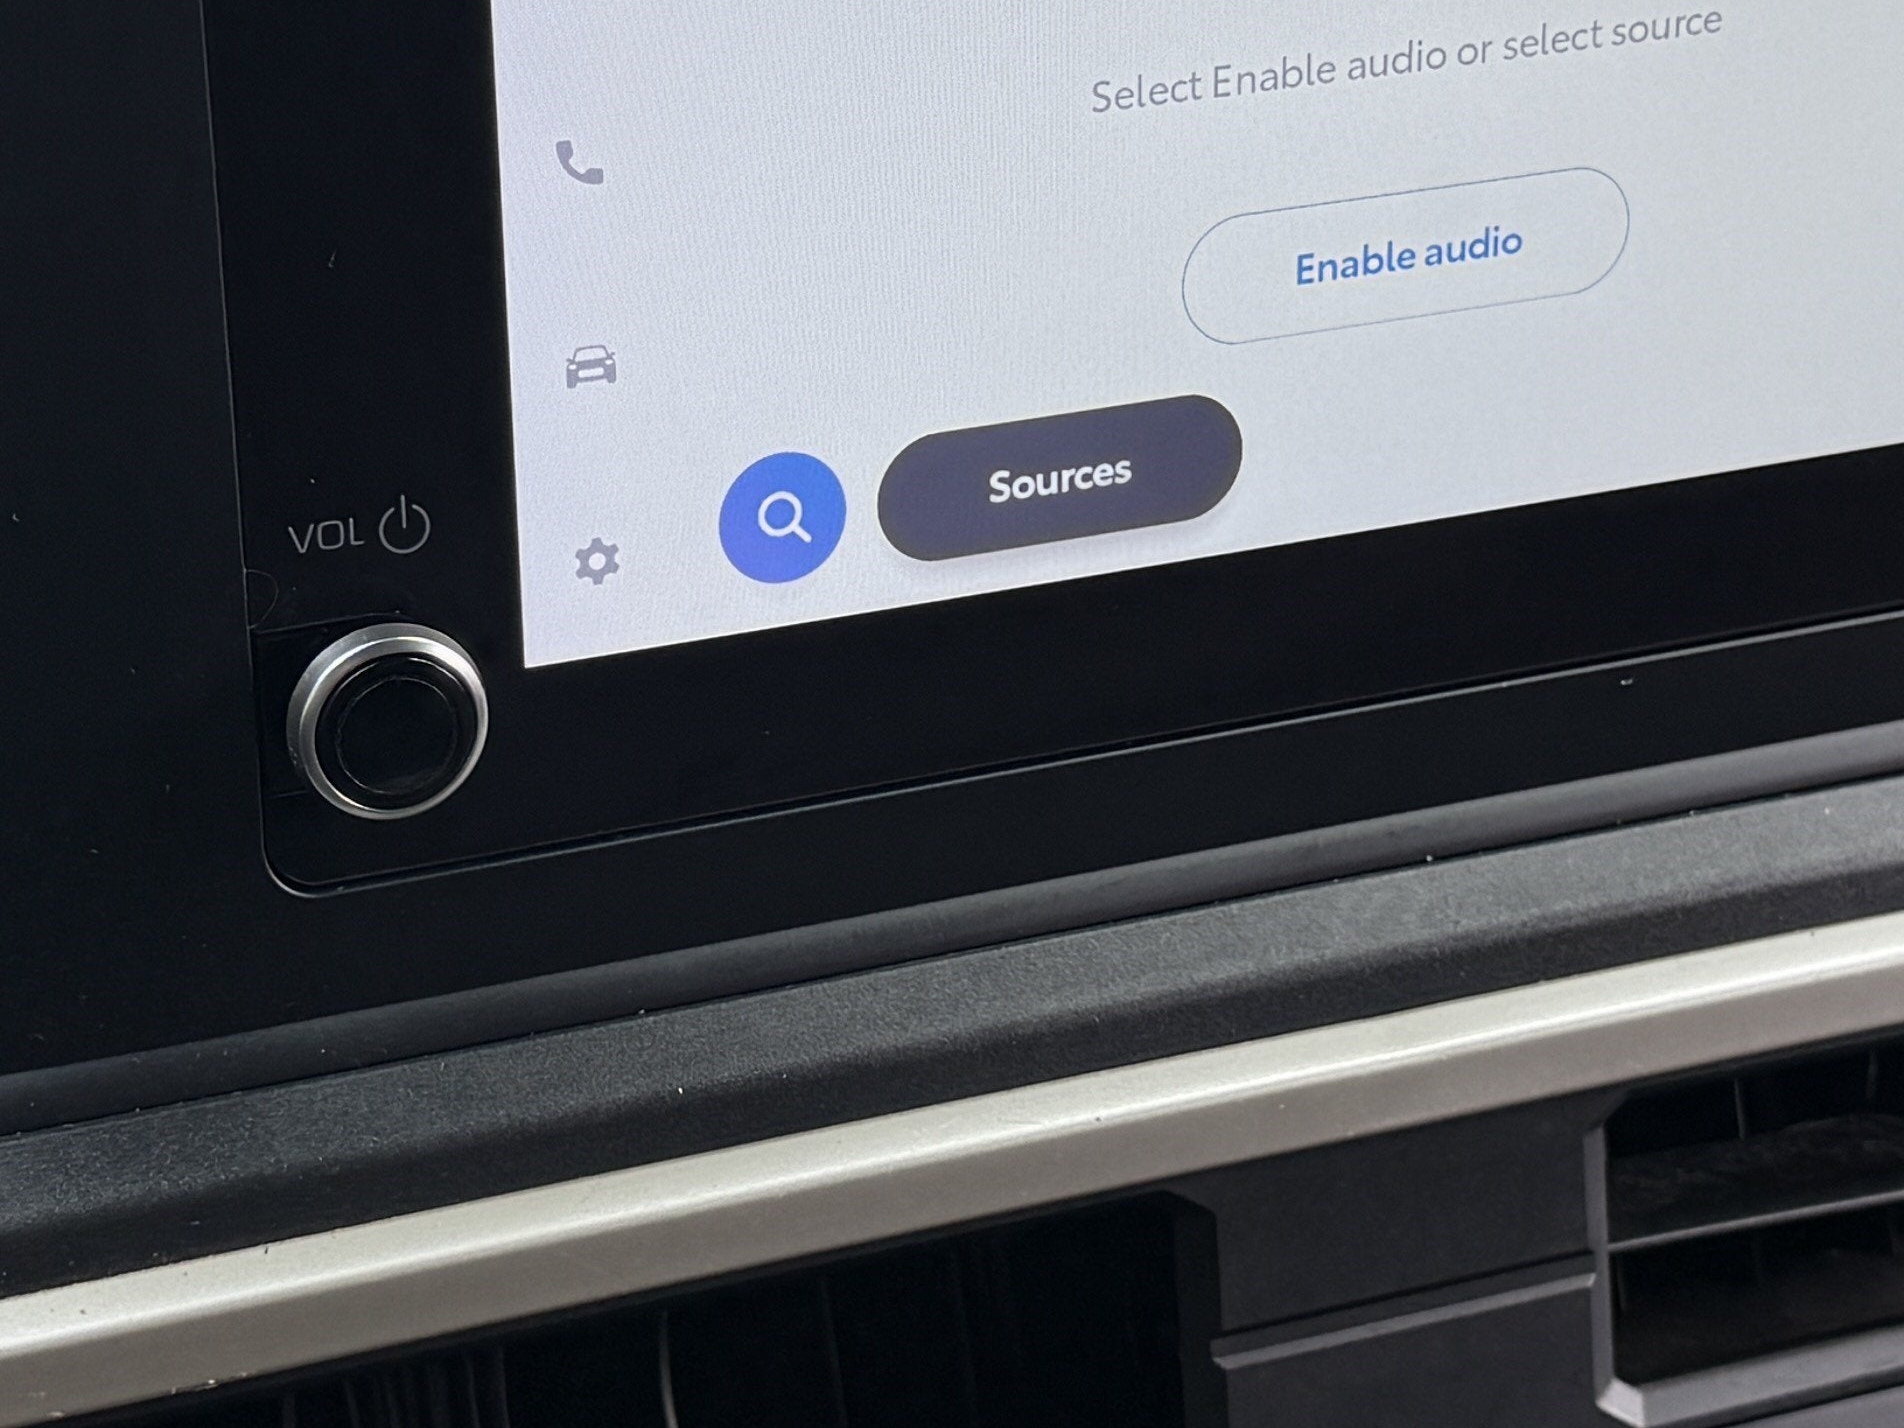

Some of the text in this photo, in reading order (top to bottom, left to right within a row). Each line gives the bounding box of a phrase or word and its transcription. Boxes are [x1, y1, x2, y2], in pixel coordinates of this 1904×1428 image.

[1092, 10, 1724, 113] Select Enable audio or select source
[1296, 225, 1524, 286] Enable audio
[988, 459, 1133, 504] Sources
[287, 516, 366, 555] VOL
